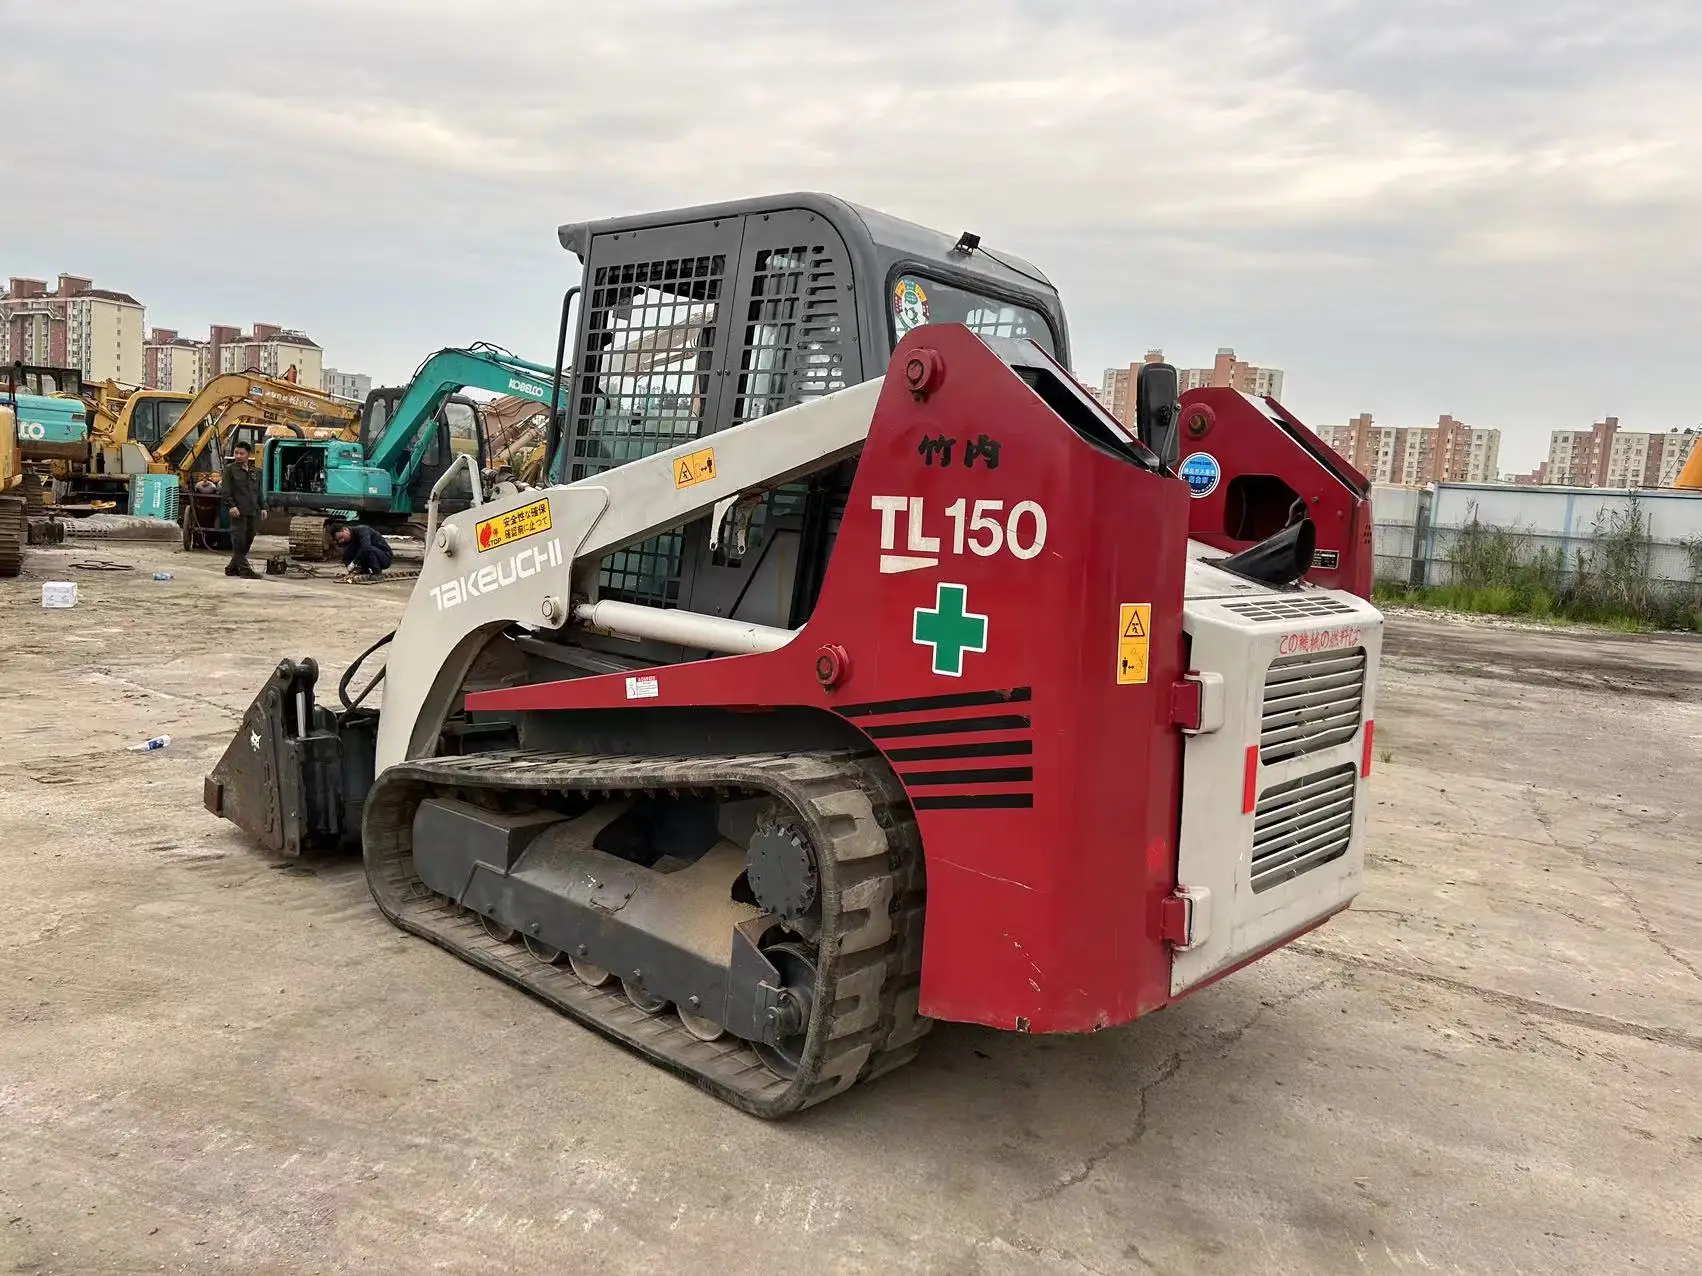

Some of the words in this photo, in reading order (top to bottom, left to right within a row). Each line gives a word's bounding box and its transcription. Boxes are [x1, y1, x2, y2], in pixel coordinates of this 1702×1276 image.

[508, 378, 544, 397] KOBELCO
[918, 434, 1001, 469] 竹内
[486, 537, 502, 548] STOP
[430, 537, 563, 611] TAKEUCHI
